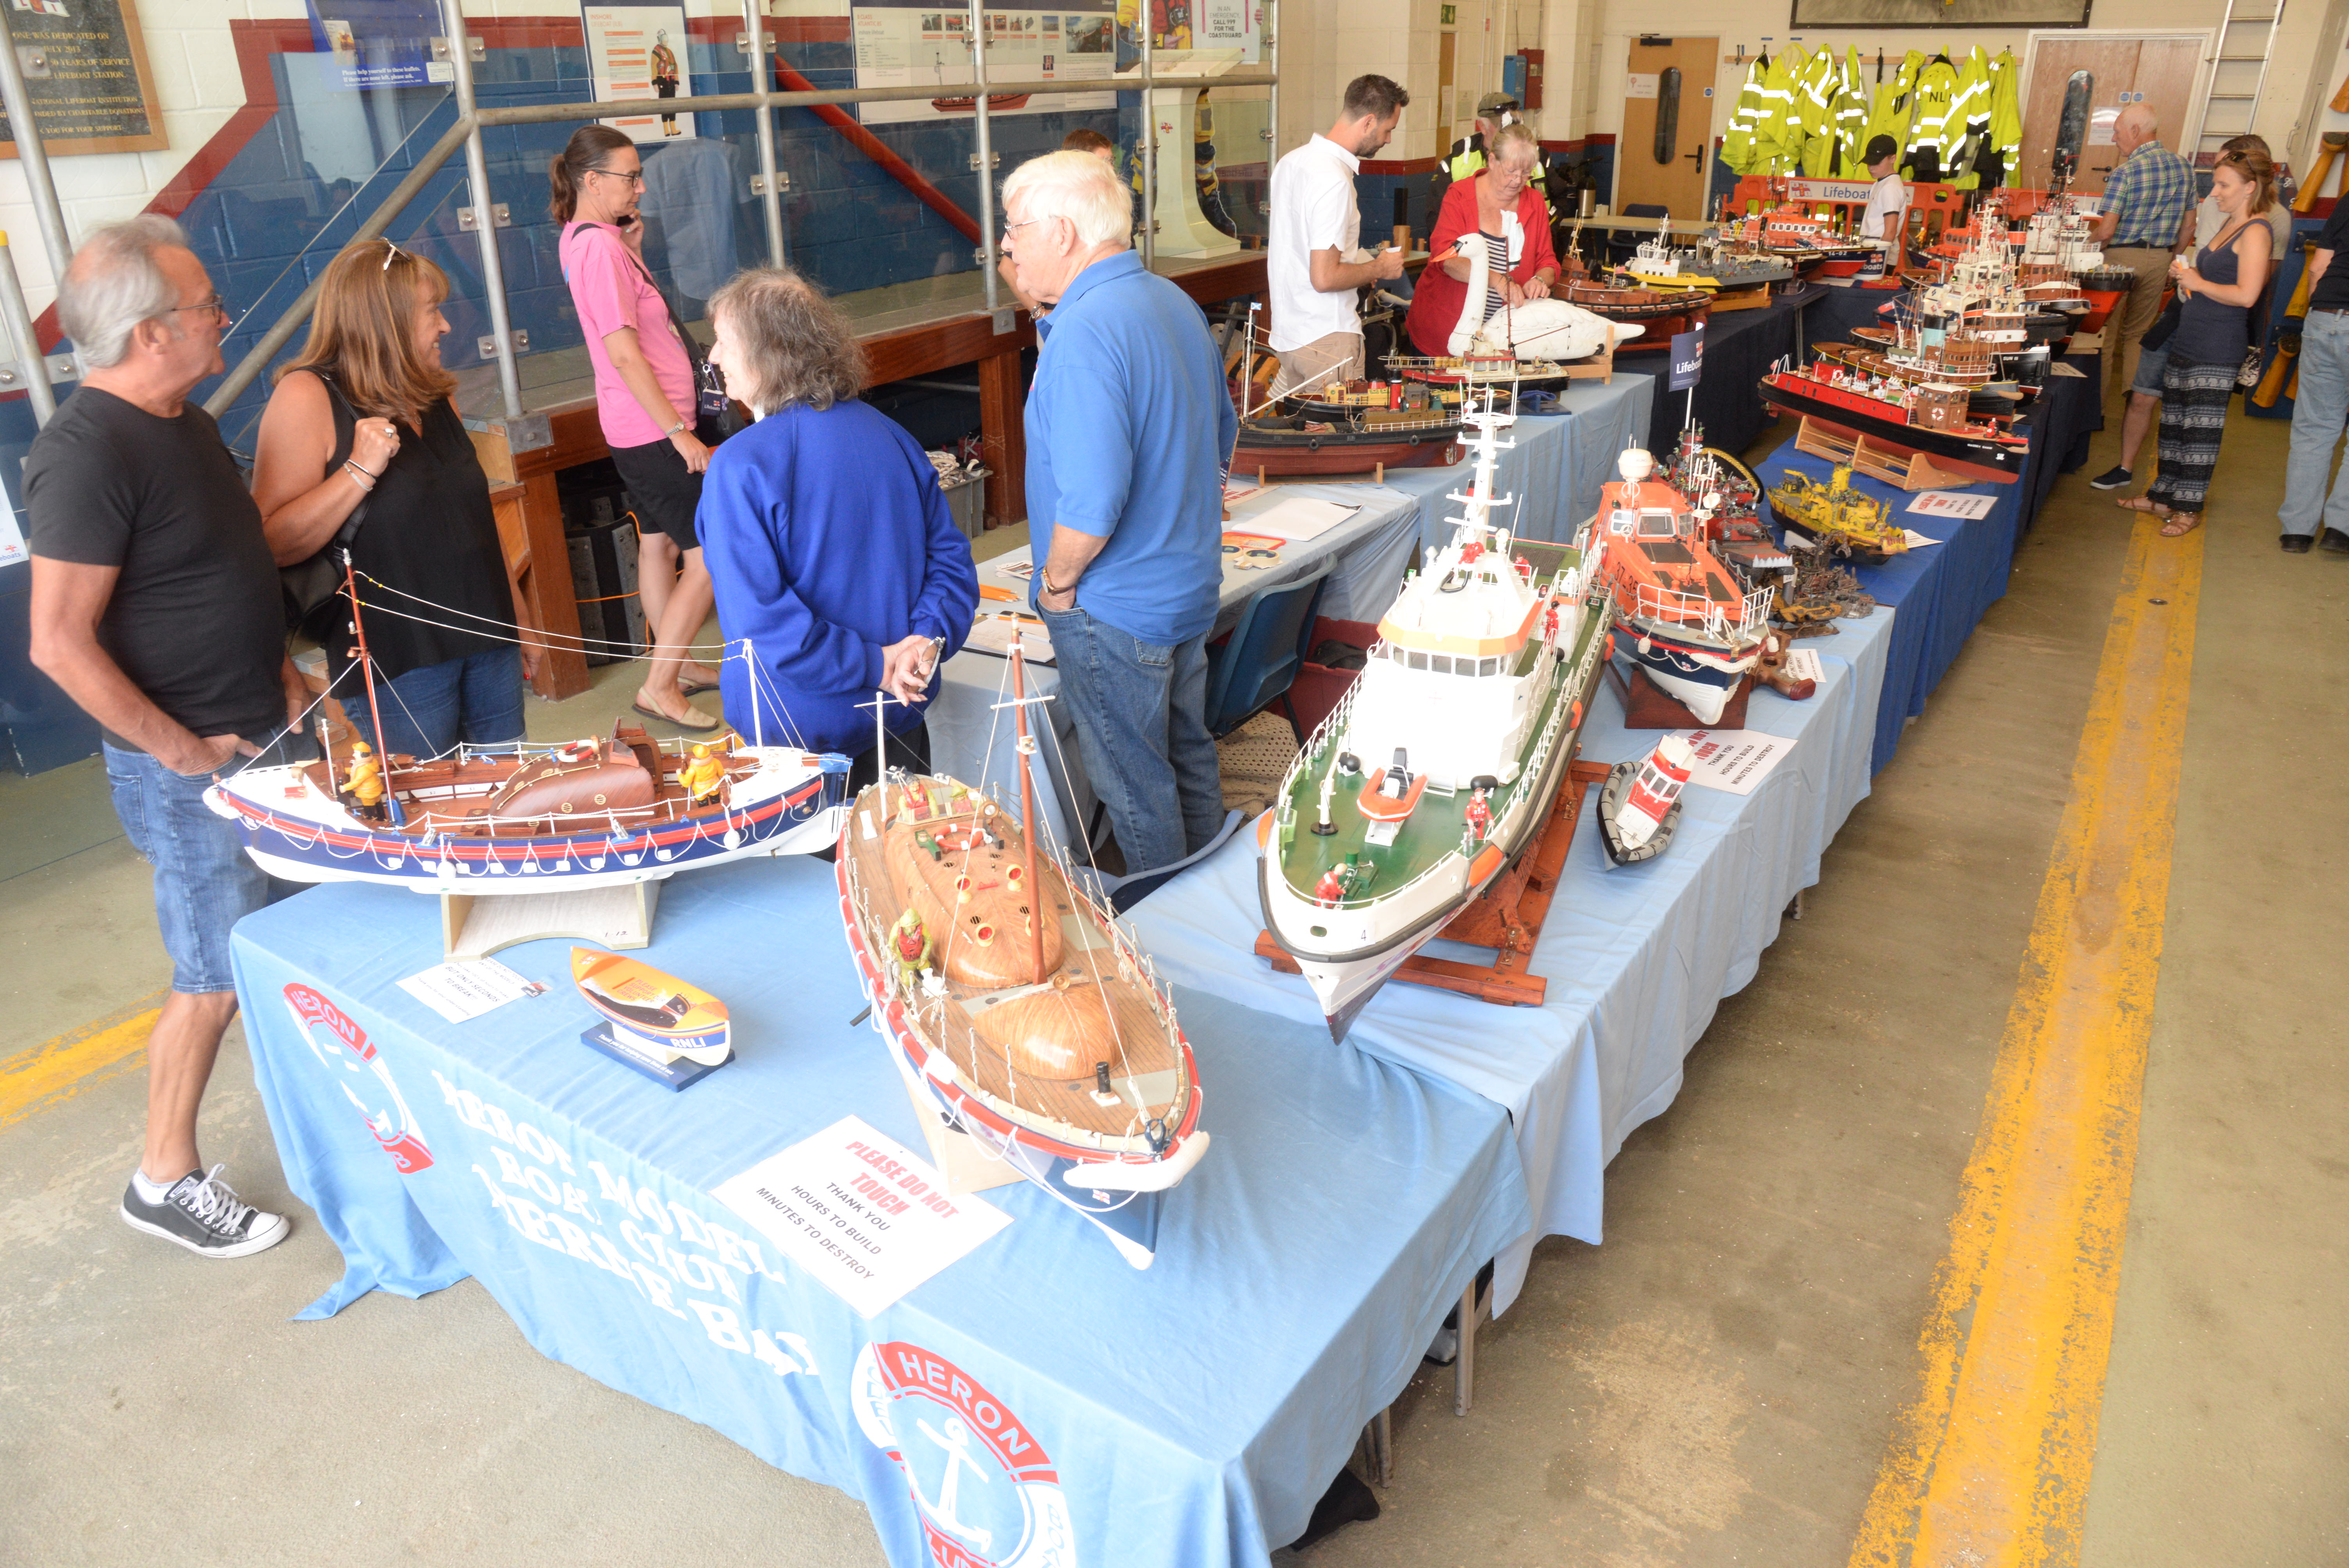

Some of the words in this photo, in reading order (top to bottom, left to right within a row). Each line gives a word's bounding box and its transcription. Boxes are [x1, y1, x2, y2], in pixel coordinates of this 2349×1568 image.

[1823, 187, 1873, 200] Lifeboat
[1688, 730, 1710, 741] NOT
[1707, 754, 1726, 766] THANK
[1722, 745, 1735, 754] YOU
[1719, 761, 1738, 775] HOURS
[1739, 745, 1754, 757] BUILD
[1731, 766, 1753, 785] MINUTES
[1754, 744, 1775, 761] DESTROY
[1360, 929, 1367, 941] 4
[445, 966, 460, 974] BUT
[457, 974, 474, 984] ONLY
[471, 984, 500, 1002] SECONDS
[617, 989, 637, 1001] CREWS
[624, 985, 655, 1003] VOLUNTEER
[629, 982, 654, 1000] SUPPORT
[635, 979, 658, 991] PLEASE
[599, 1034, 611, 1043] Thank
[624, 1047, 640, 1058] helping
[649, 1059, 661, 1067] lives
[670, 1037, 706, 1049] RNLI
[845, 1140, 908, 1180] PLEASE
[896, 1173, 930, 1196] DO
[919, 1190, 960, 1219] NOT
[849, 1171, 911, 1216] TOUCH
[791, 1185, 831, 1215] HOURS
[829, 1213, 847, 1228] TO
[845, 1227, 882, 1255] BUILD
[826, 1182, 866, 1213] THANK
[864, 1211, 892, 1231] YOU
[756, 1187, 805, 1226] MINUTES
[804, 1224, 822, 1239] TO
[818, 1238, 875, 1279] DESTROY
[898, 1351, 1032, 1456] HERON
